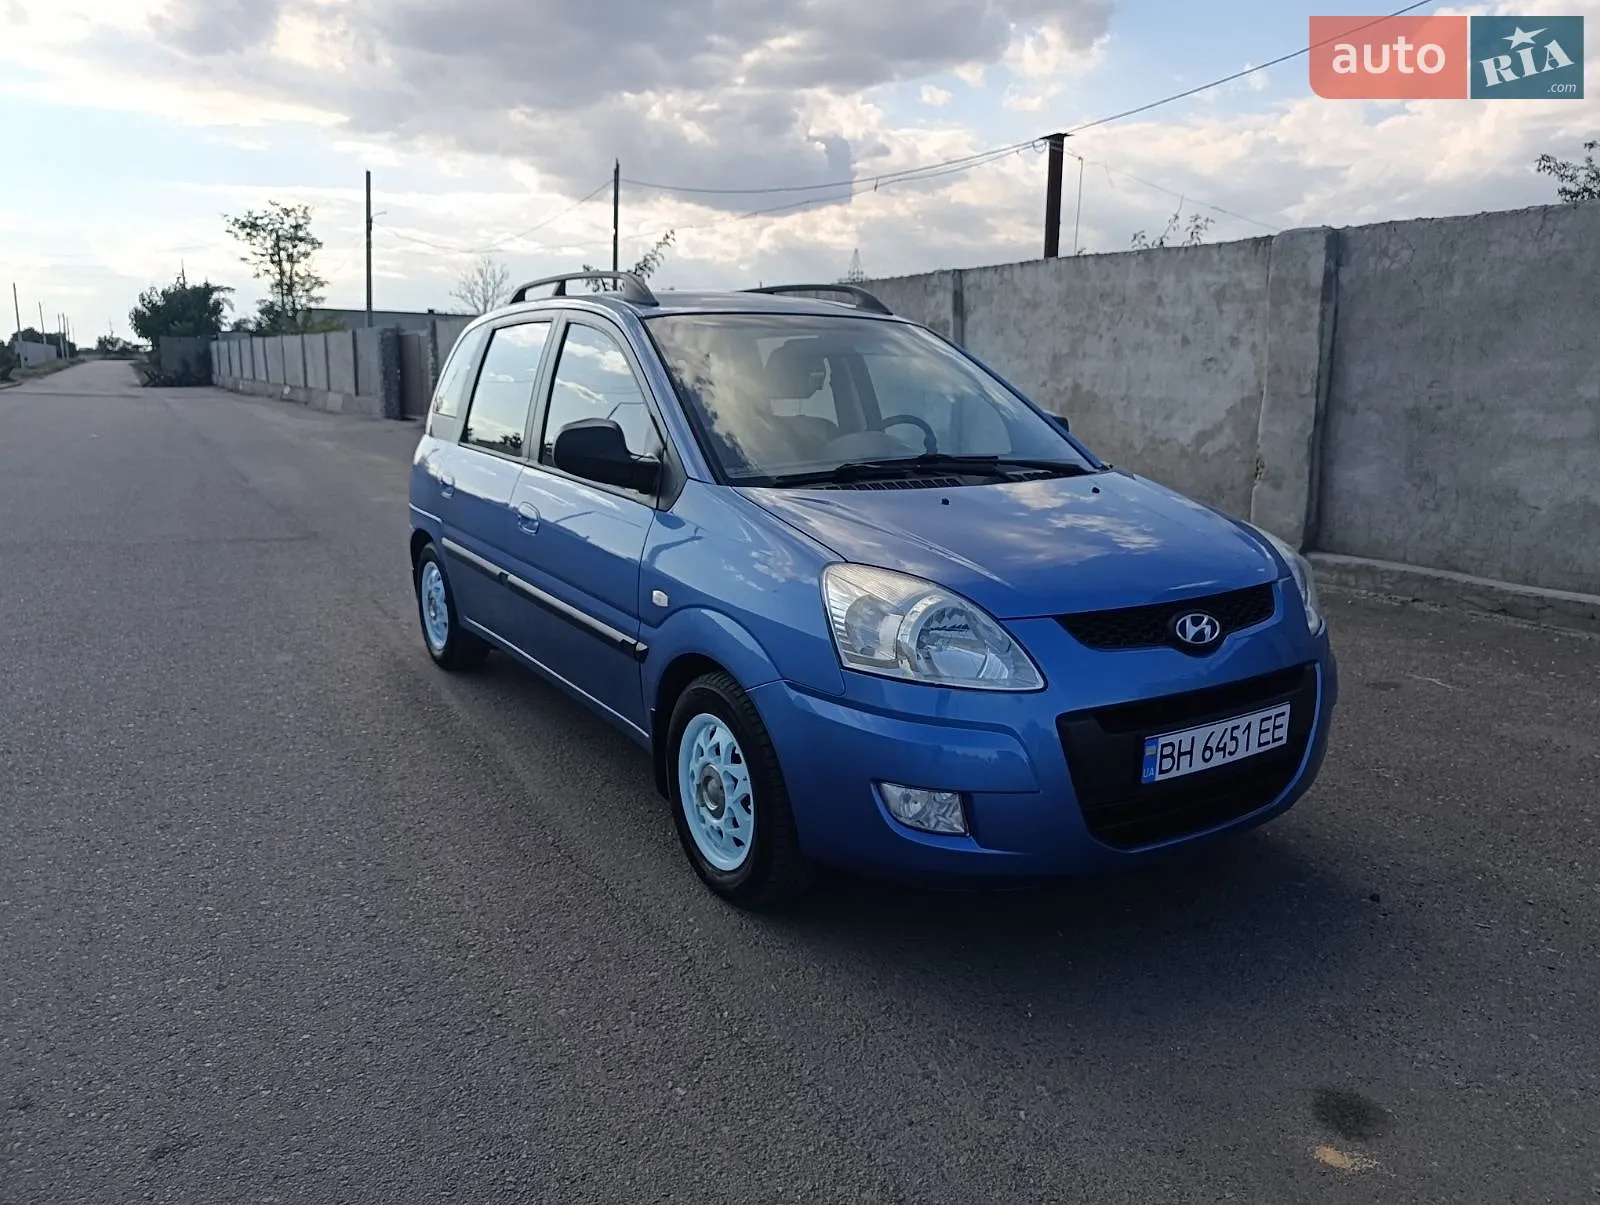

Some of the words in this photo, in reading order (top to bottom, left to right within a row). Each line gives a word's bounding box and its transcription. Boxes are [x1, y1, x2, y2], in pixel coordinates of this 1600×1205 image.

[1158, 736, 1195, 775] BH
[1201, 721, 1252, 763] 6451
[1257, 711, 1286, 748] EE
[1142, 767, 1155, 778] UA
